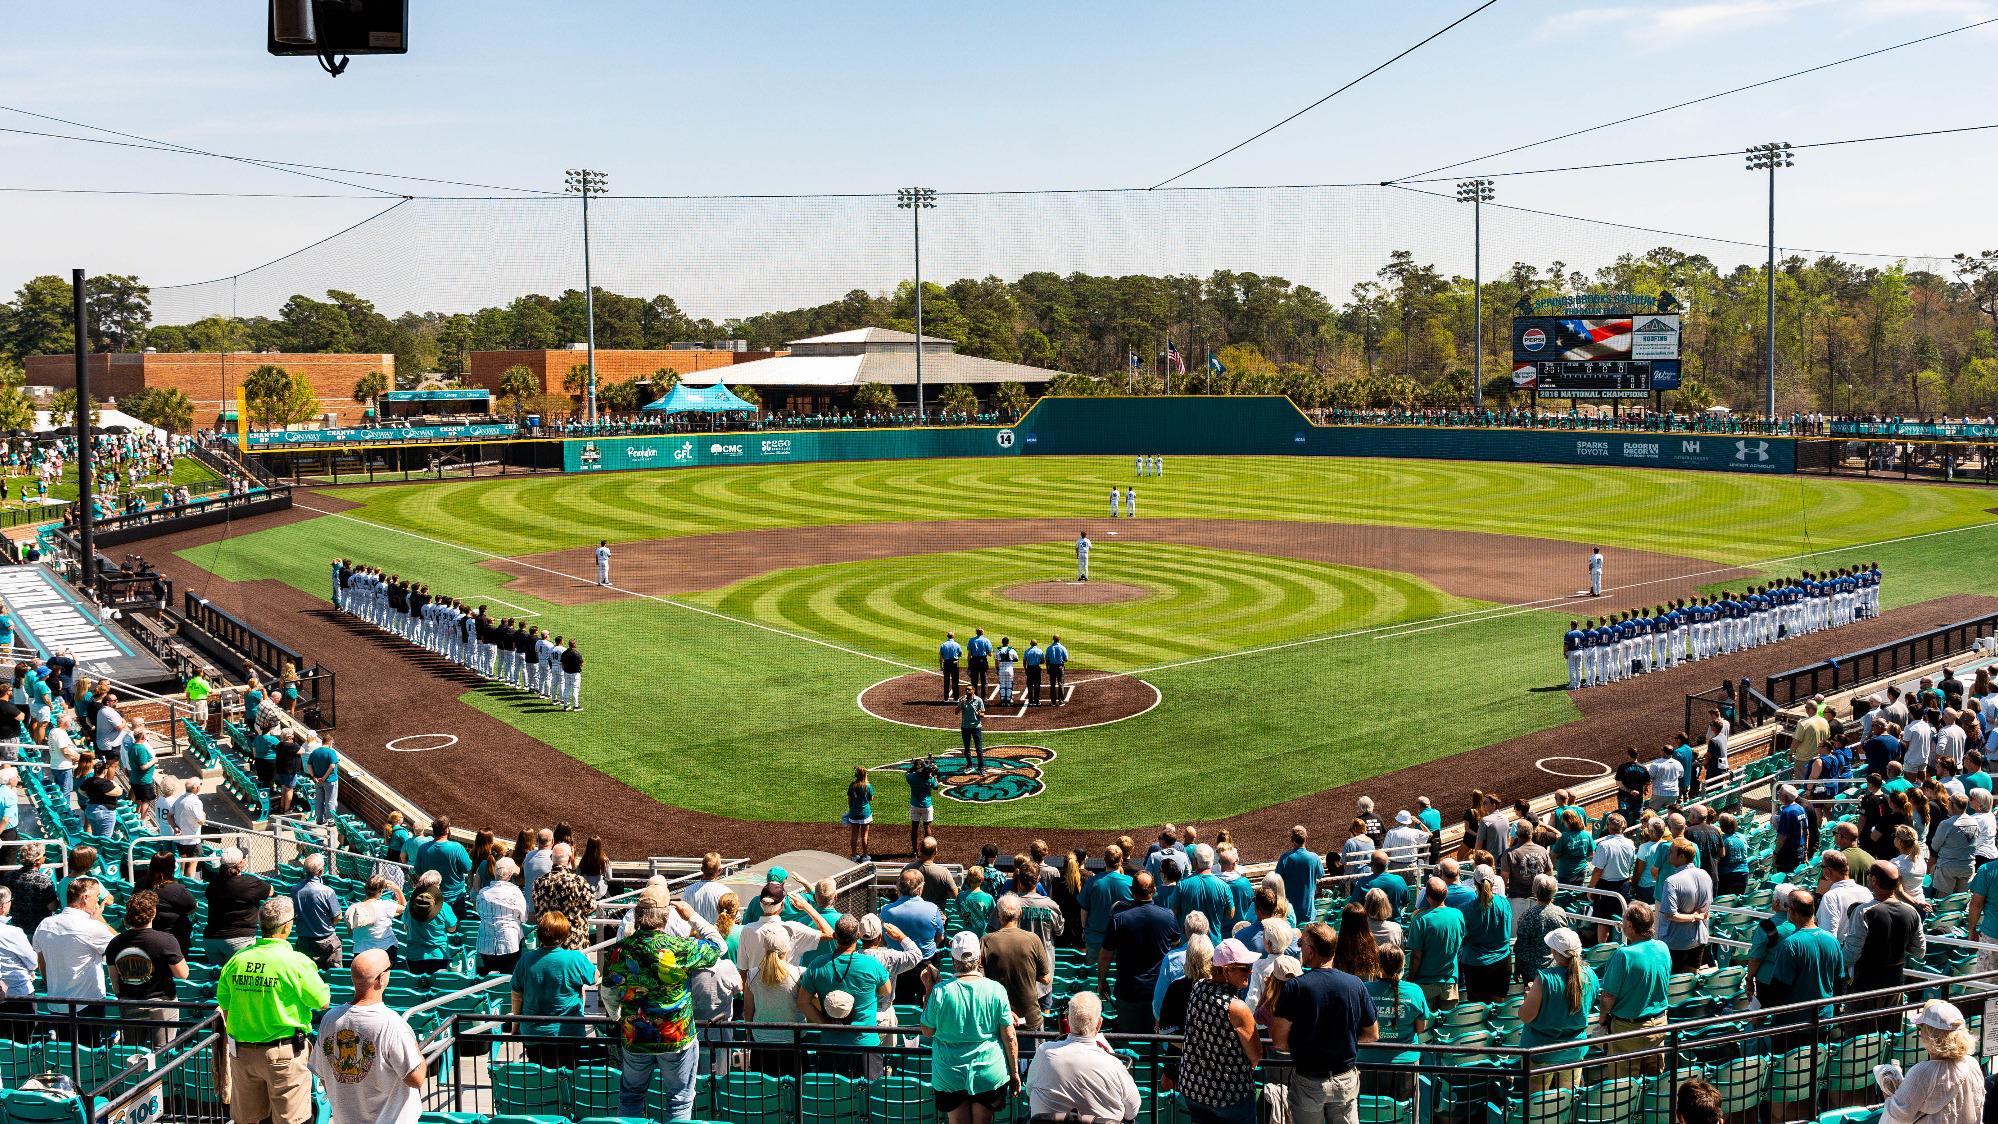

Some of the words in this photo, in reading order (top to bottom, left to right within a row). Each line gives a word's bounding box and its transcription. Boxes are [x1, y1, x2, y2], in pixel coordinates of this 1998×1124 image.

[1535, 296, 1573, 309] SPRINGS
[1575, 294, 1612, 305] BROOKS
[1614, 294, 1656, 306] STADIUM
[402, 428, 435, 438] CONWAY
[470, 425, 500, 435] CONWAY
[1893, 423, 1930, 434] CONWAY
[285, 432, 321, 442] CONWAY
[361, 429, 394, 439] CONWAY
[1000, 435, 1012, 444] 14
[722, 444, 743, 453] CMC
[1577, 441, 1608, 449] SPARKS
[1682, 440, 1700, 453] NH
[626, 446, 658, 458] Revolution
[674, 449, 692, 459] GFL
[1577, 448, 1608, 456] TOYOTA
[157, 807, 170, 820] 18
[245, 962, 265, 973] EPI
[254, 975, 279, 988] STAFF
[130, 1095, 158, 1124] 106
